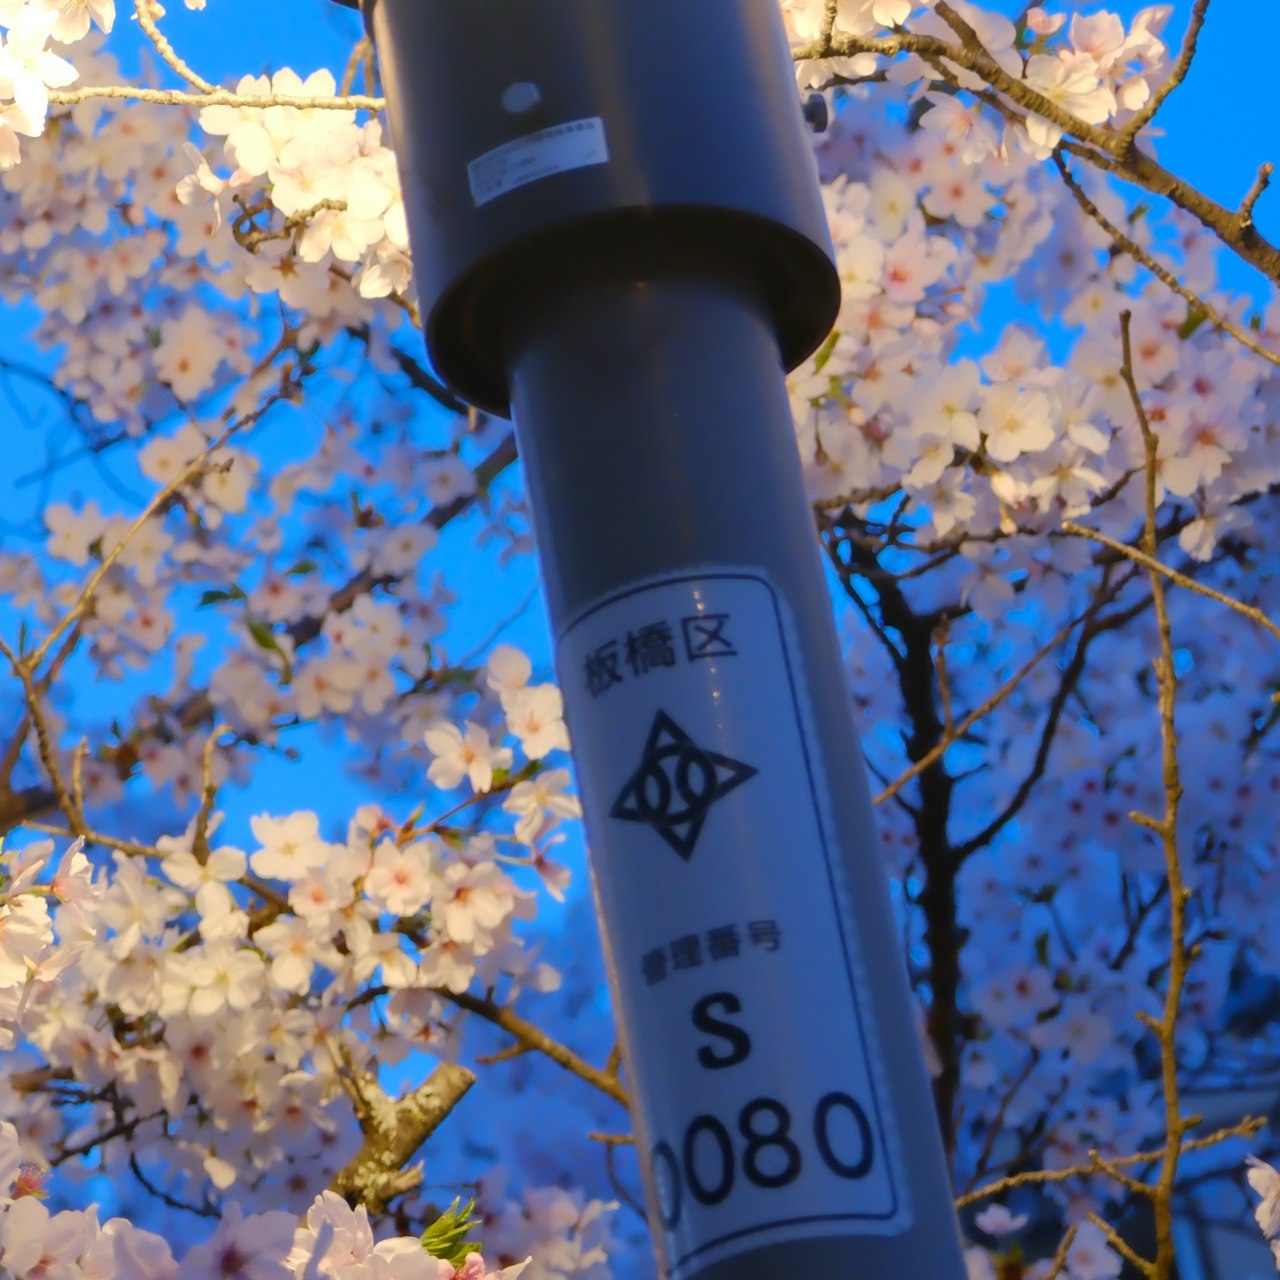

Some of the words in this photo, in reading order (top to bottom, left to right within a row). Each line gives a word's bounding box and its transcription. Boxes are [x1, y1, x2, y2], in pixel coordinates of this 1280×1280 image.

[584, 613, 738, 699] 板橋区
[691, 991, 751, 1070] S
